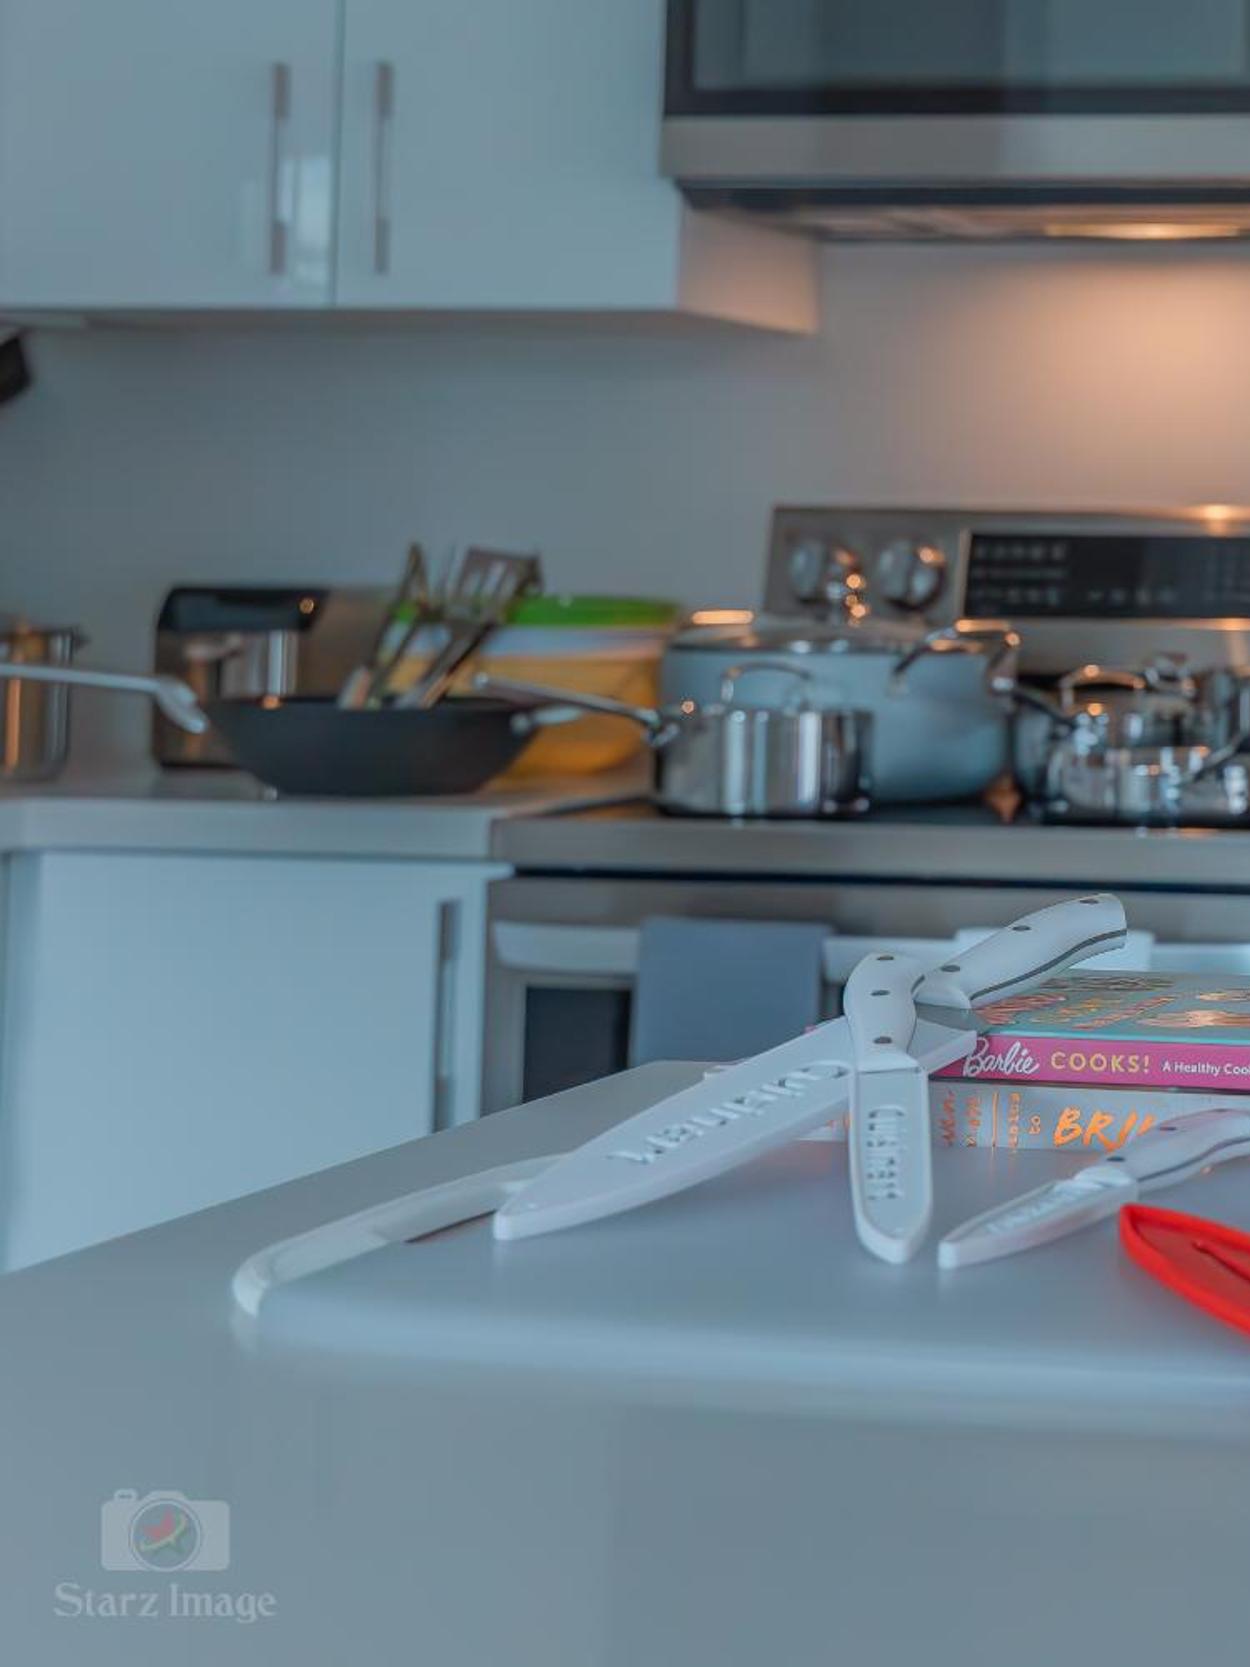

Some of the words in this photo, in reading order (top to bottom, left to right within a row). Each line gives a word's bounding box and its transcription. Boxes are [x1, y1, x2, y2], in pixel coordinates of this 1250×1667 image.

[962, 1036, 1040, 1077] Barbie
[1050, 1051, 1150, 1075] COOKS!
[1161, 1060, 1172, 1073] A
[1173, 1061, 1221, 1077] Healthy
